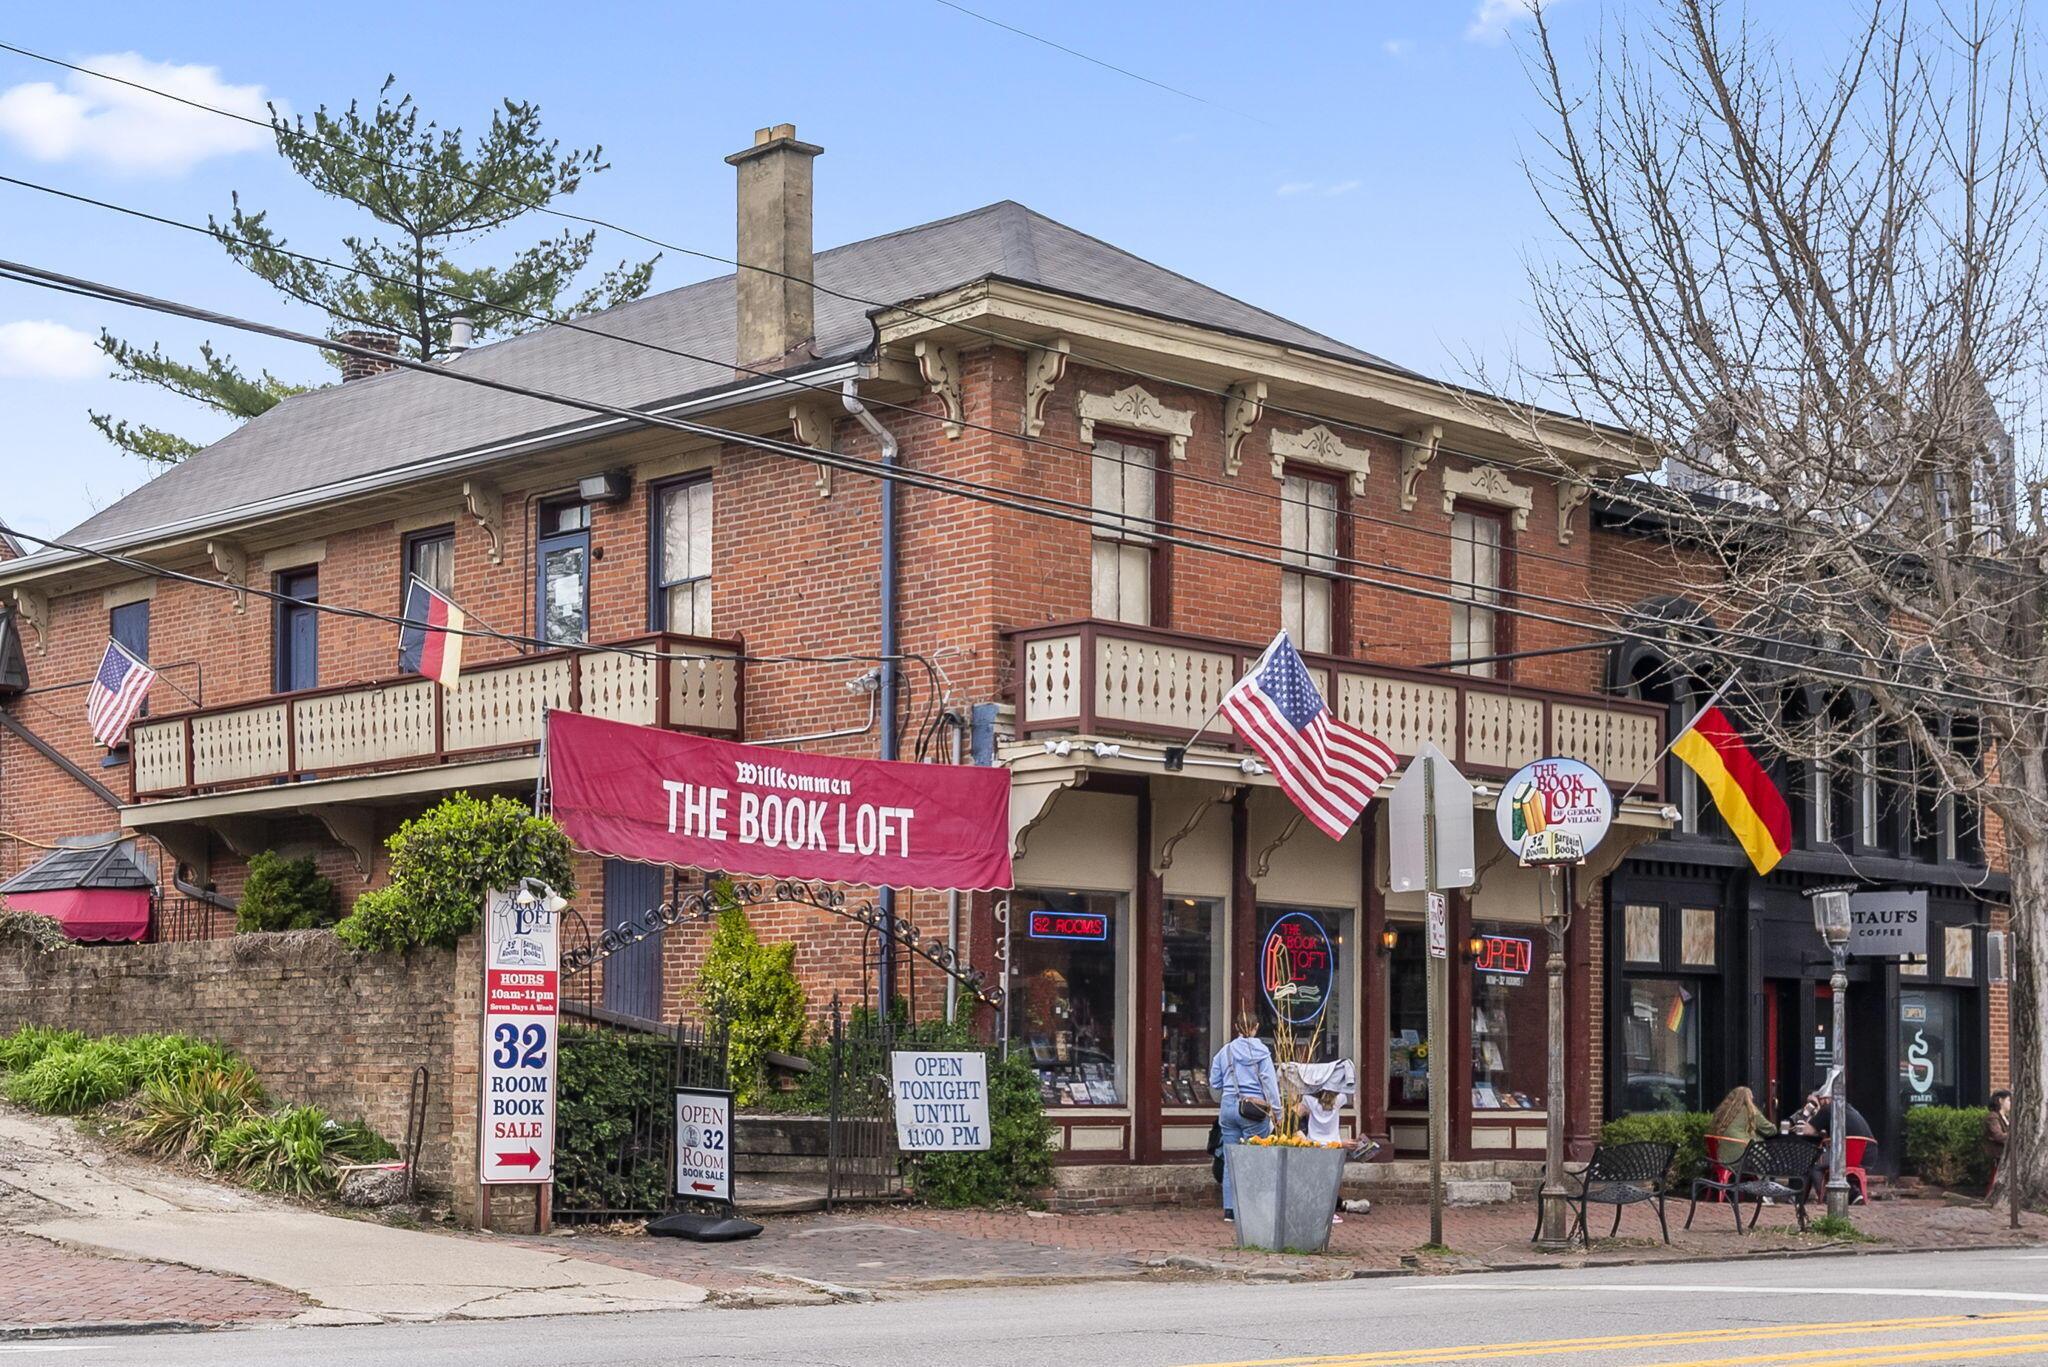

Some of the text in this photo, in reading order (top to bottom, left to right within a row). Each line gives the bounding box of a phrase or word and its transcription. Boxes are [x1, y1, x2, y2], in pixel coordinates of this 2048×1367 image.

[735, 761, 852, 796] Willkommen
[1531, 764, 1558, 778] THE
[1536, 774, 1584, 793] BOOK
[1541, 788, 1598, 825] LOFT
[1553, 807, 1602, 817] OF GERMAN
[662, 779, 915, 858] THE BOOK LOFT
[1566, 816, 1602, 824] VILLAGE
[1554, 833, 1580, 847] Bargain
[1525, 846, 1549, 859] Rooms
[1554, 845, 1579, 857] Books
[514, 909, 552, 935] LOFT
[1033, 917, 1102, 934] 32 ROOMS
[1280, 923, 1301, 936] THE
[1858, 928, 1903, 937] COFFEE
[1286, 935, 1318, 949] BOOK
[500, 973, 545, 986] HOURS
[491, 989, 555, 1003] 10am-11pm
[489, 1002, 554, 1012] Seven Days A Week
[493, 1022, 548, 1070] 32
[914, 1057, 963, 1077] OPEN
[491, 1075, 548, 1093] ROOM
[900, 1080, 981, 1100] TONIGHT
[493, 1098, 545, 1116] BOOK
[681, 1104, 725, 1126] OPEN
[913, 1103, 971, 1124] UNTIL
[495, 1121, 543, 1139] SALE
[907, 1126, 980, 1147] 11:00 PM
[702, 1128, 724, 1151] 32
[682, 1146, 725, 1170] ROOM
[682, 1167, 725, 1181] BOOK SALE
